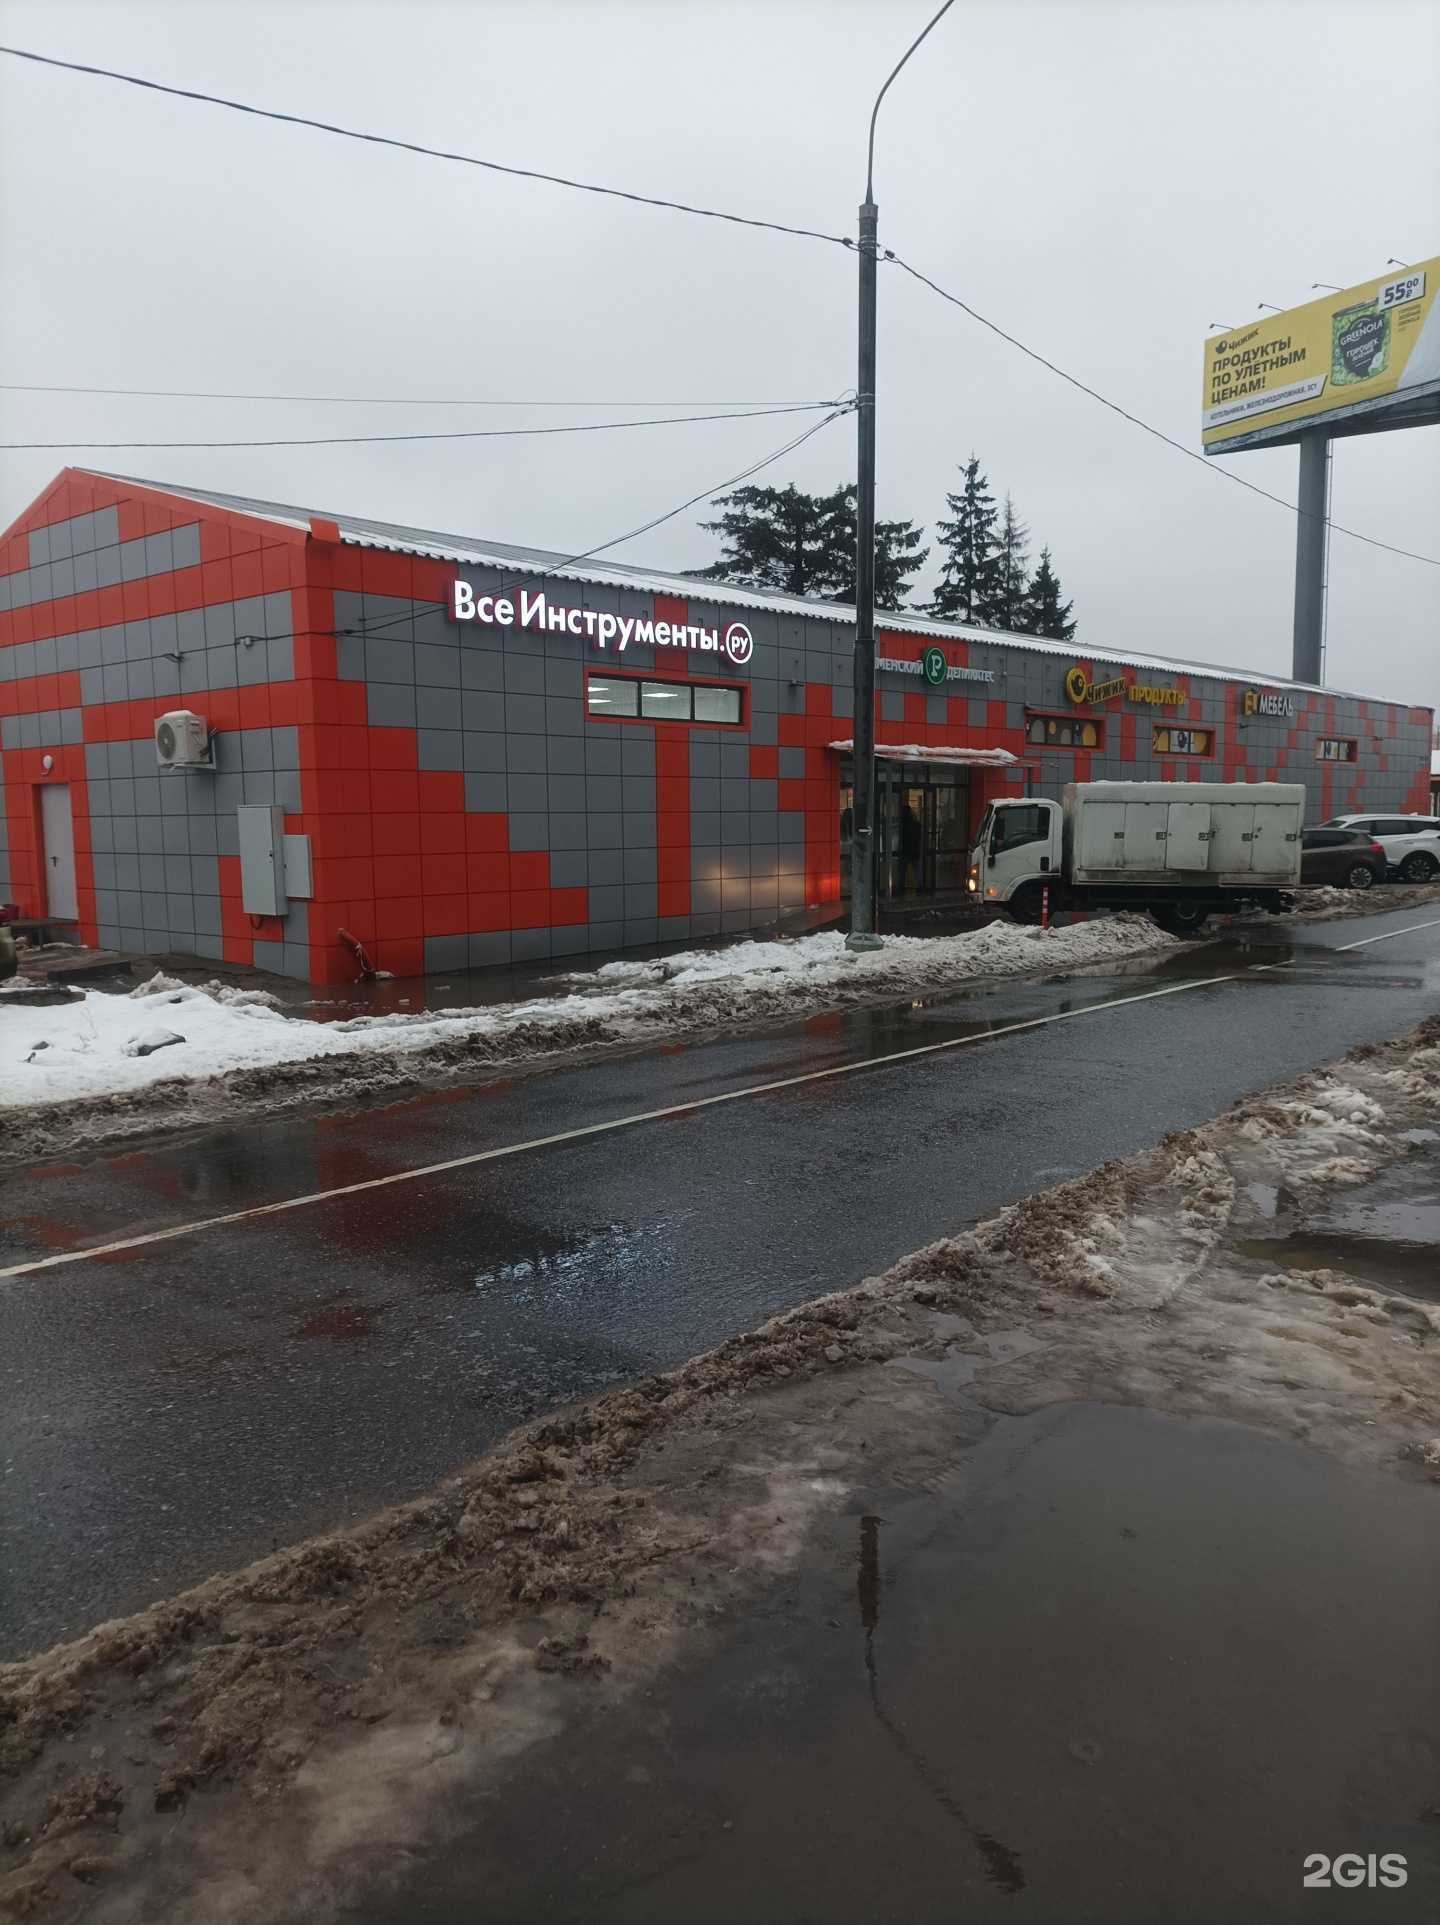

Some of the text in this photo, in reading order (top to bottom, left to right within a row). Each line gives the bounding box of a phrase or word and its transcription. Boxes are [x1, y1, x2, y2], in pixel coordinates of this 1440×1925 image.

[1212, 336, 1291, 373] ПРОДУКТЫ
[1211, 376, 1266, 404] ЦЕНАМ!
[1212, 372, 1231, 388] ПО
